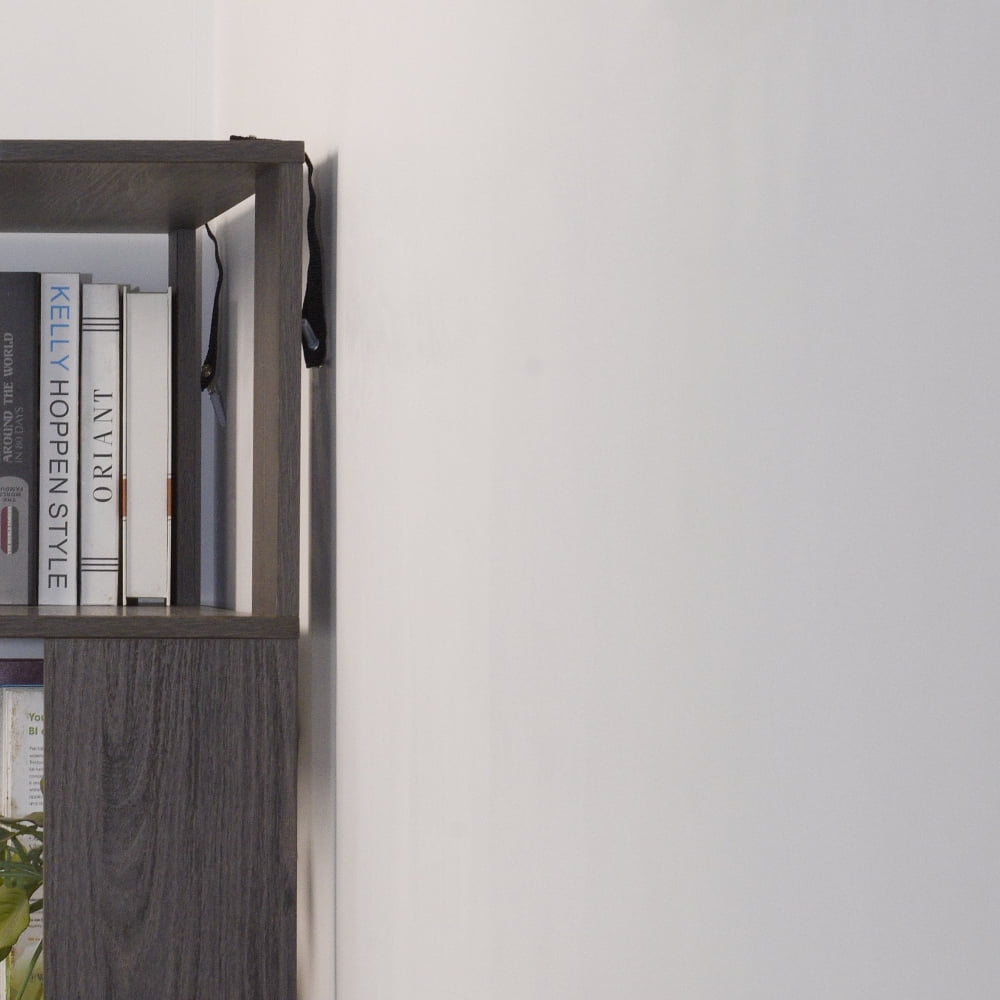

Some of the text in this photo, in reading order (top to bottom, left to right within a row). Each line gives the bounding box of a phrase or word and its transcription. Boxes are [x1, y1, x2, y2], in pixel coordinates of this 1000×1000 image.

[2, 332, 14, 464] AROUND THE WORLD
[14, 407, 24, 464] IN 80 DAYS
[47, 285, 71, 590] KELLY HOPPEN STYLE
[92, 388, 113, 503] ORIANT
